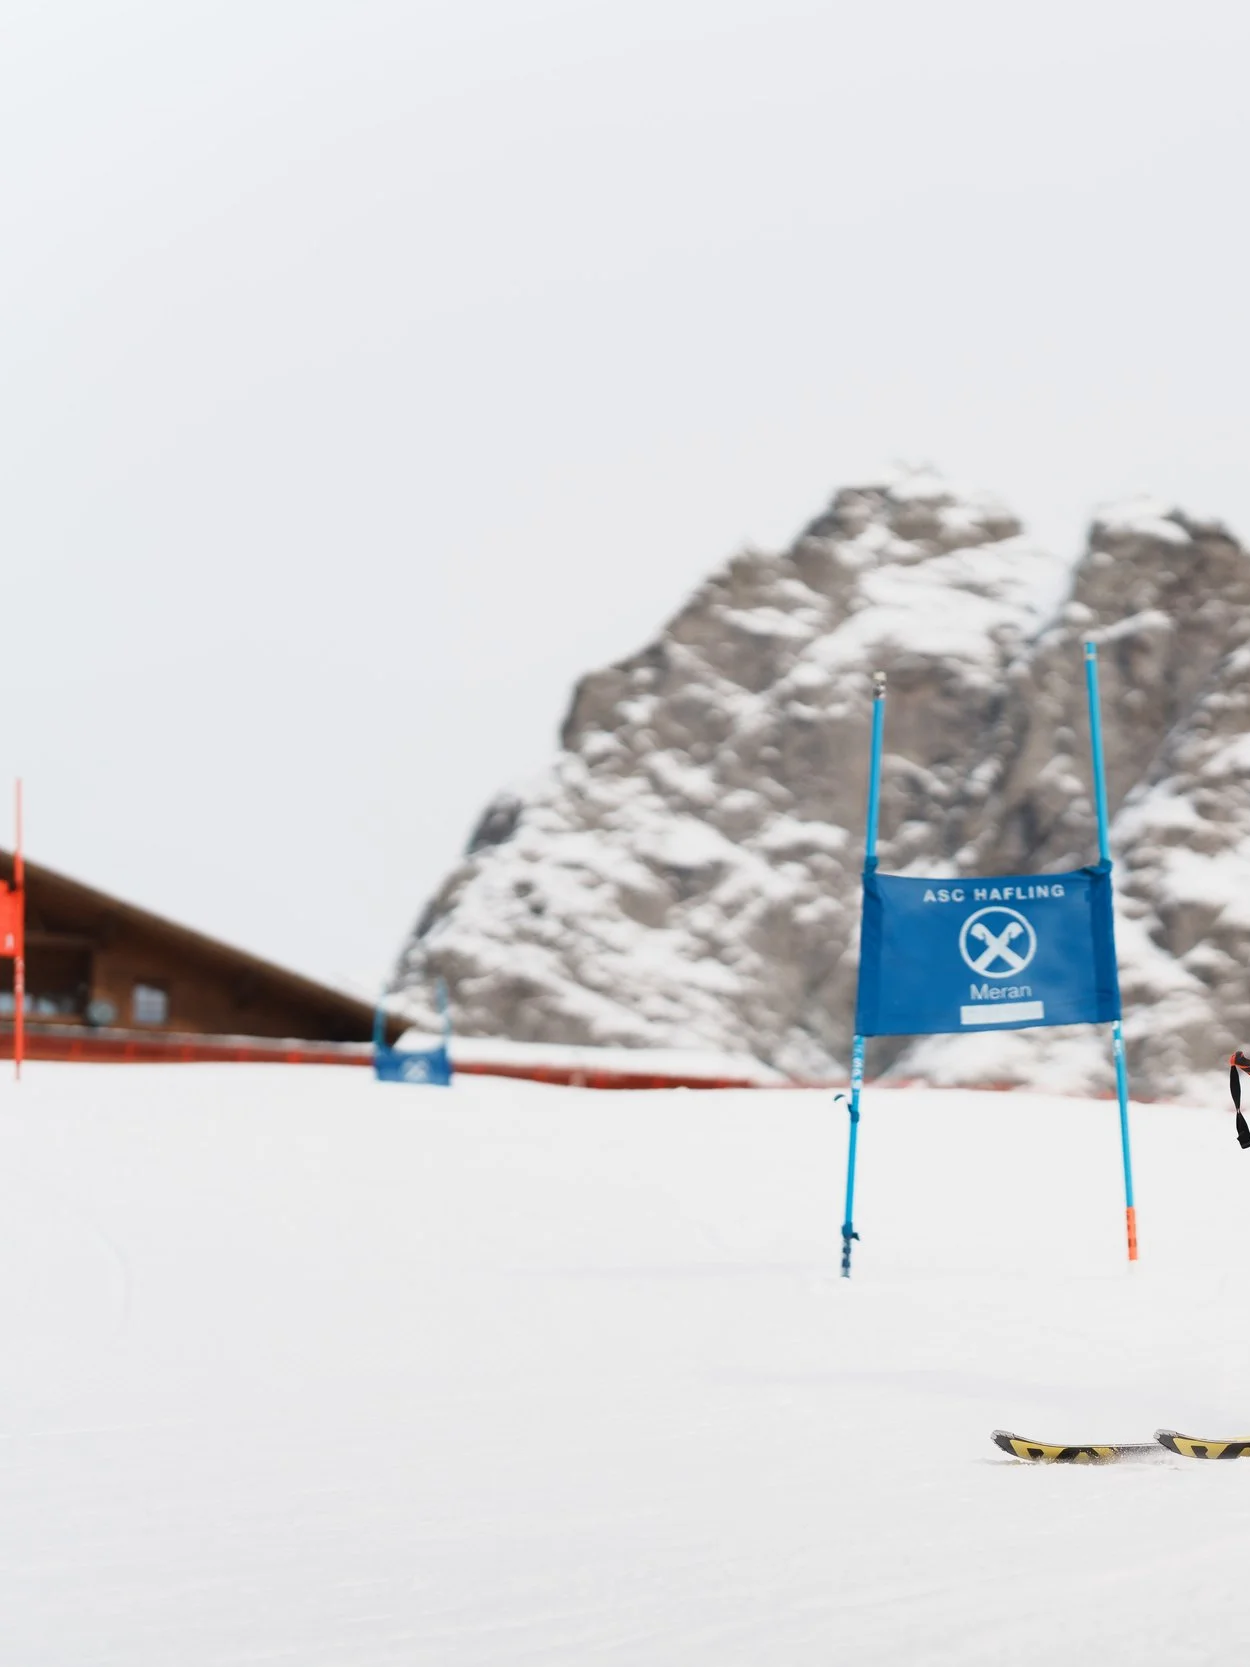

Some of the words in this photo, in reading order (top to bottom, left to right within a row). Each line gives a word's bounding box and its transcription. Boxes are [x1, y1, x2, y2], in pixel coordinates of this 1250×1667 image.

[923, 888, 965, 903] ASC
[974, 884, 1065, 901] HAFLING
[969, 983, 1033, 1001] Meran
